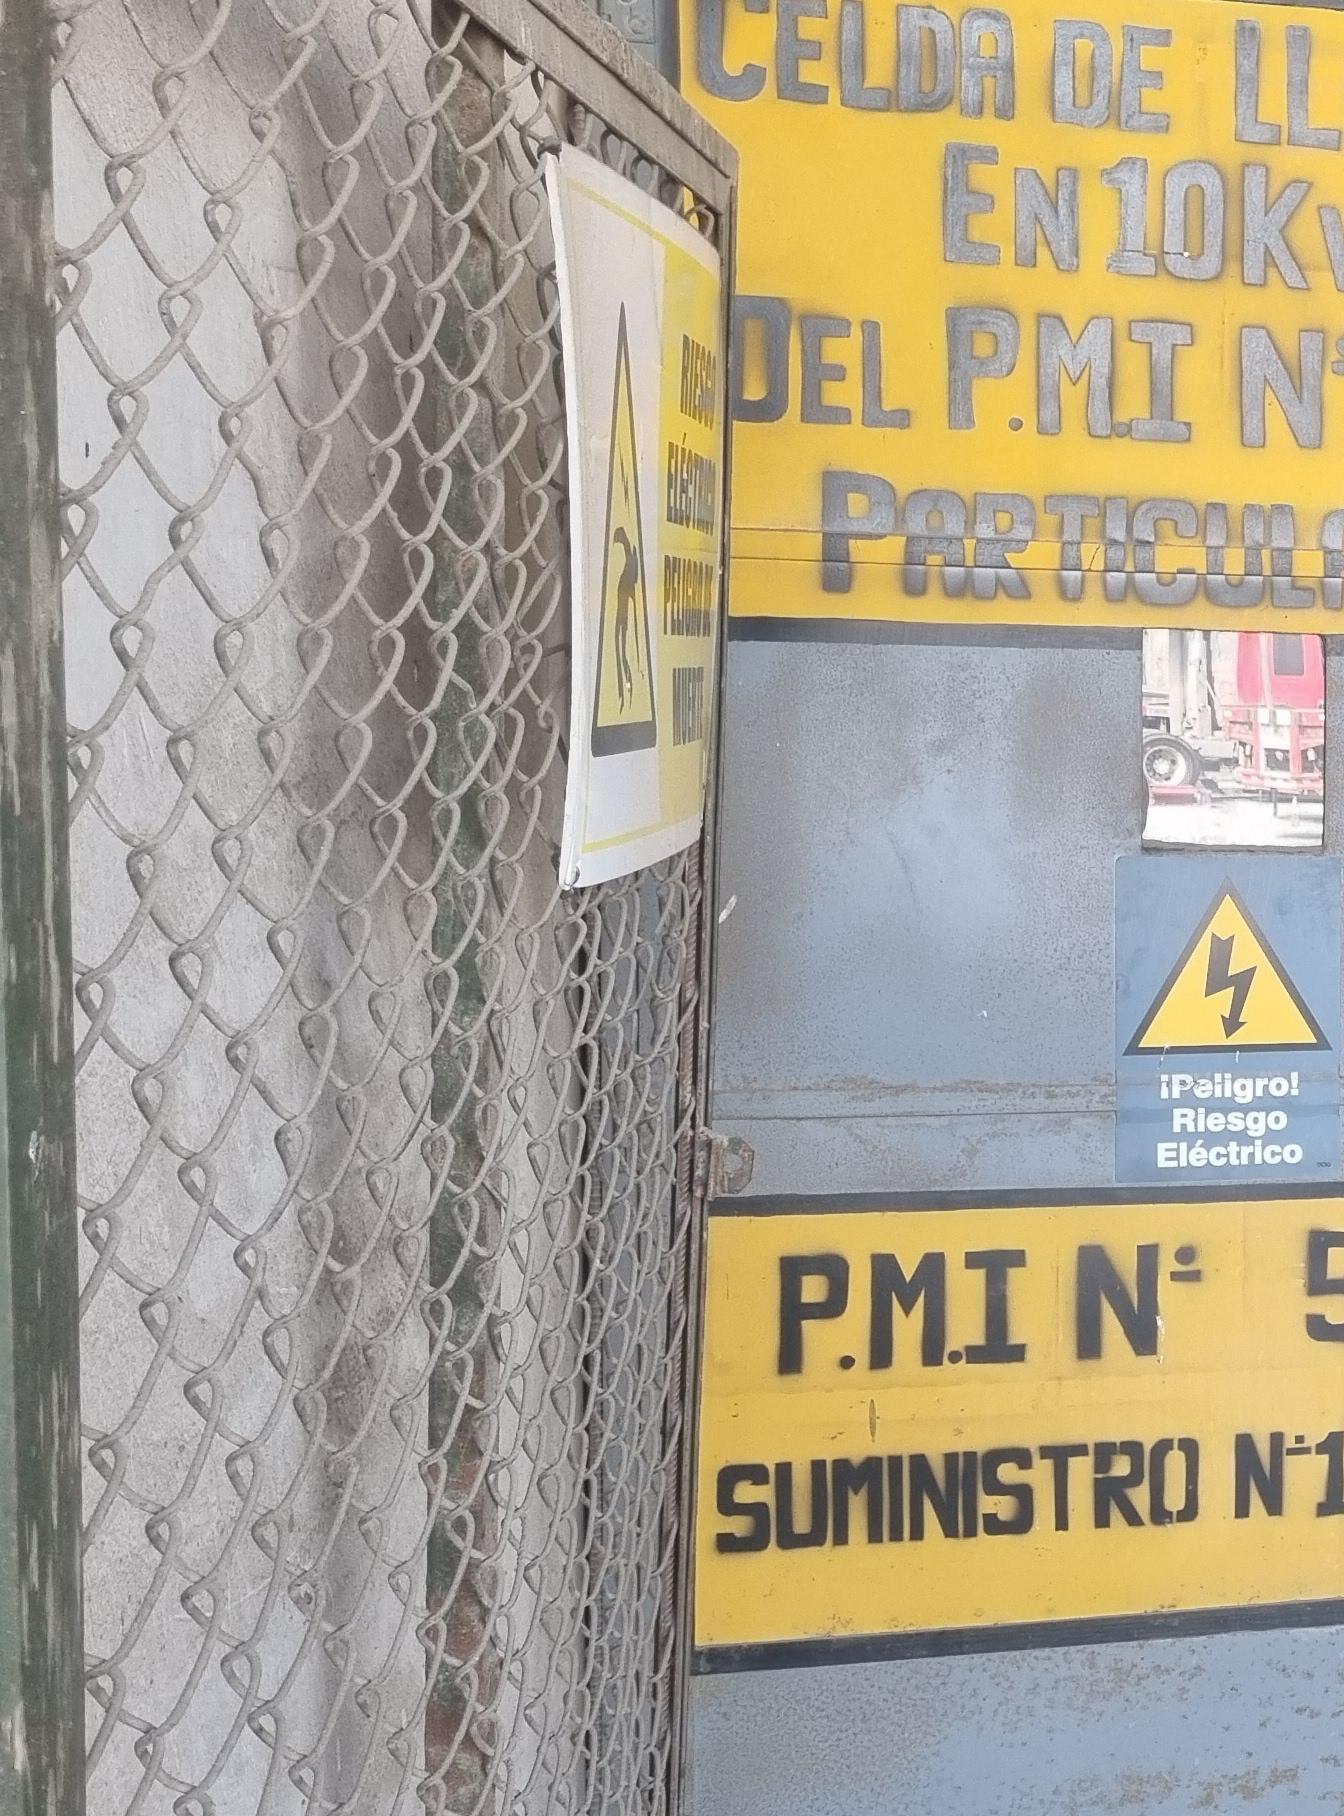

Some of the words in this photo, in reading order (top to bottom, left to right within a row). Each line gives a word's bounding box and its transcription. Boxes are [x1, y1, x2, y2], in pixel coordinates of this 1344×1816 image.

[699, 0, 1015, 121] CELDA
[1052, 17, 1172, 135] DE
[731, 295, 911, 430] DEL
[1160, 1072, 1299, 1104] ¡Peligro!
[1172, 1108, 1288, 1137] Riesgo
[1157, 1139, 1303, 1168] Eléctrico
[715, 1436, 1200, 1554] SUMINISTRO
